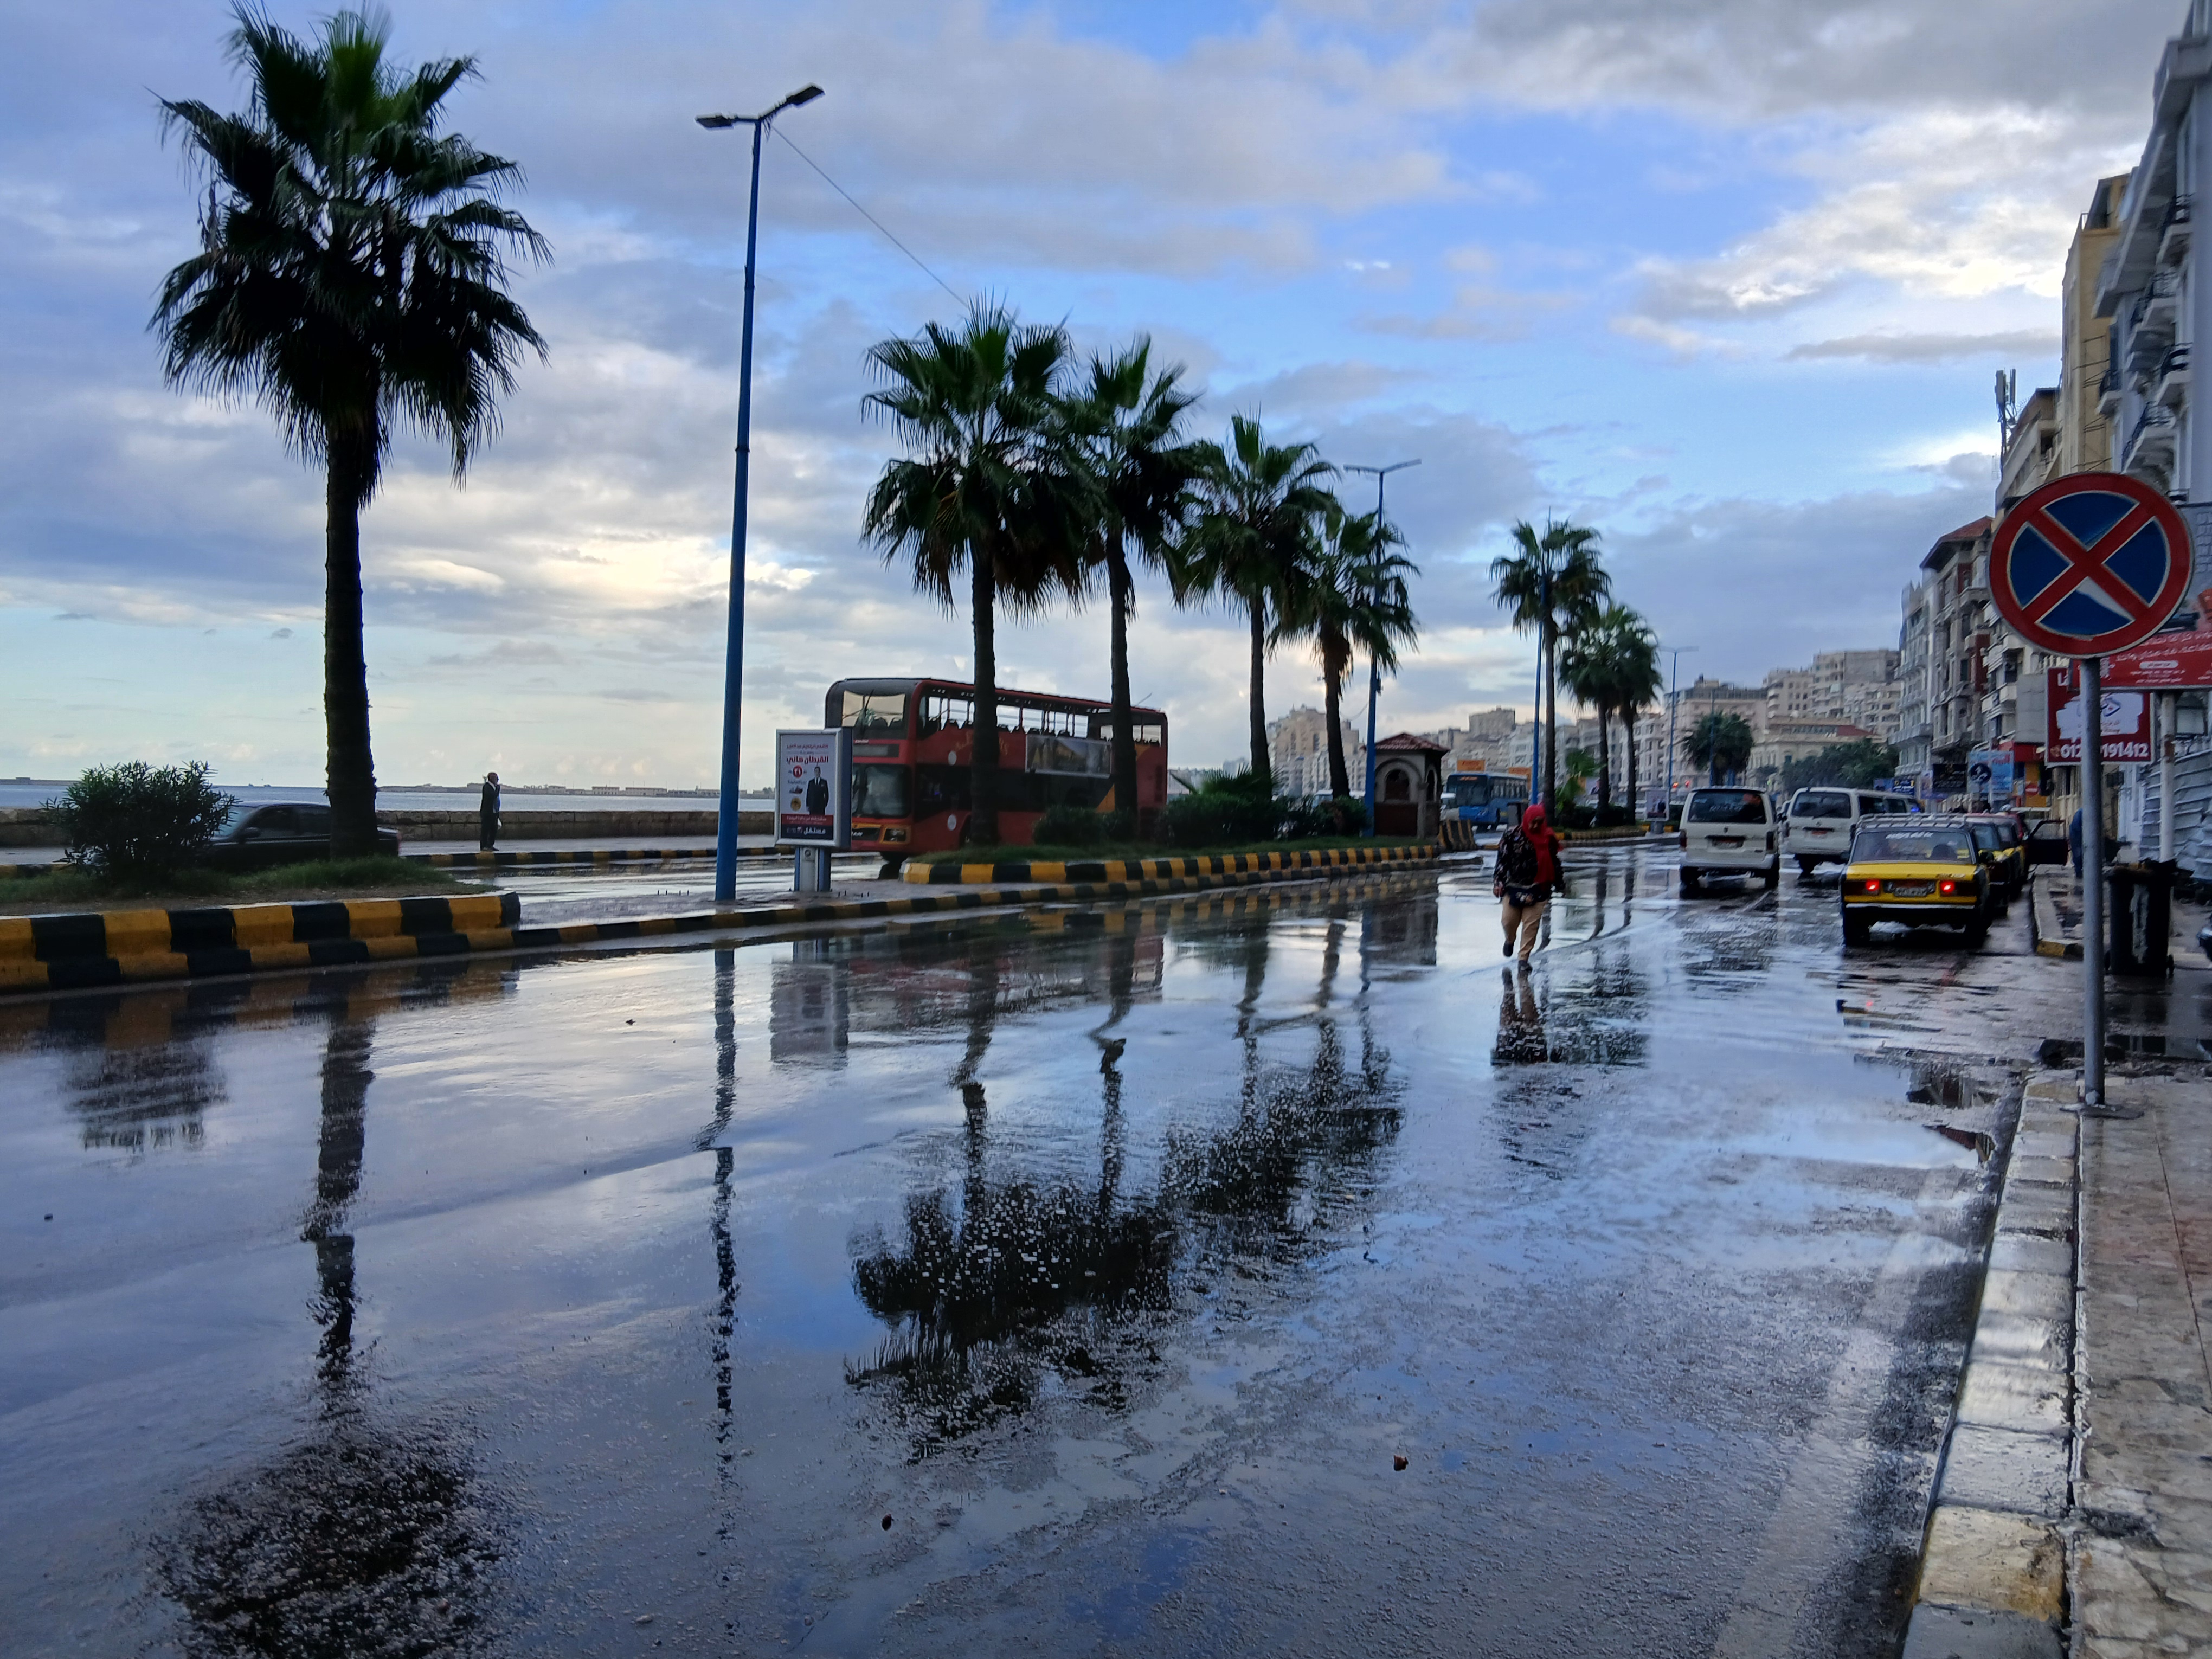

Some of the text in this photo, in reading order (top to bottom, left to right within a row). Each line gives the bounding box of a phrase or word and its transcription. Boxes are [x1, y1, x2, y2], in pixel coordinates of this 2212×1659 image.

[2060, 741, 2149, 758] 012191412
[804, 755, 828, 766] القبطان
[803, 827, 826, 835] مستقل
